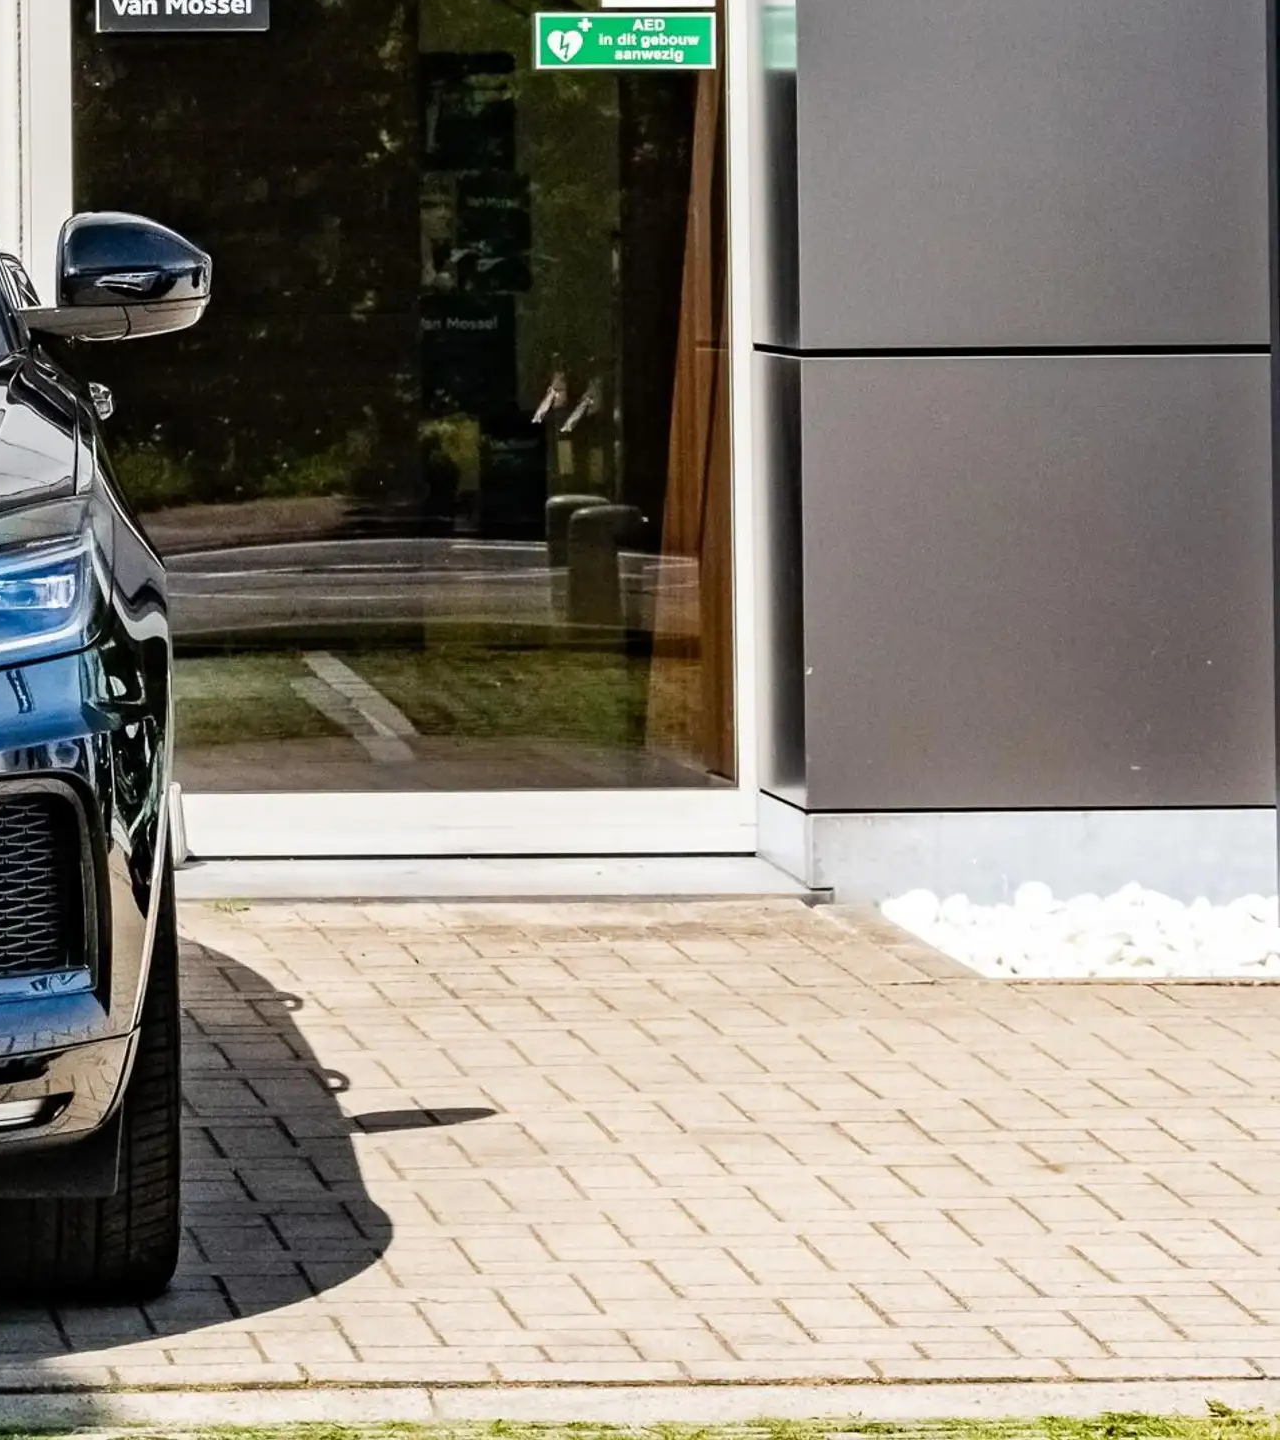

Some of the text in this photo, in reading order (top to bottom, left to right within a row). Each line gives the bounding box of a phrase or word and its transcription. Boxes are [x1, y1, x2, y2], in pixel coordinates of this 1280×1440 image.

[632, 18, 666, 32] AED
[598, 33, 700, 49] in dit gebouw
[614, 47, 685, 63] aanwezig
